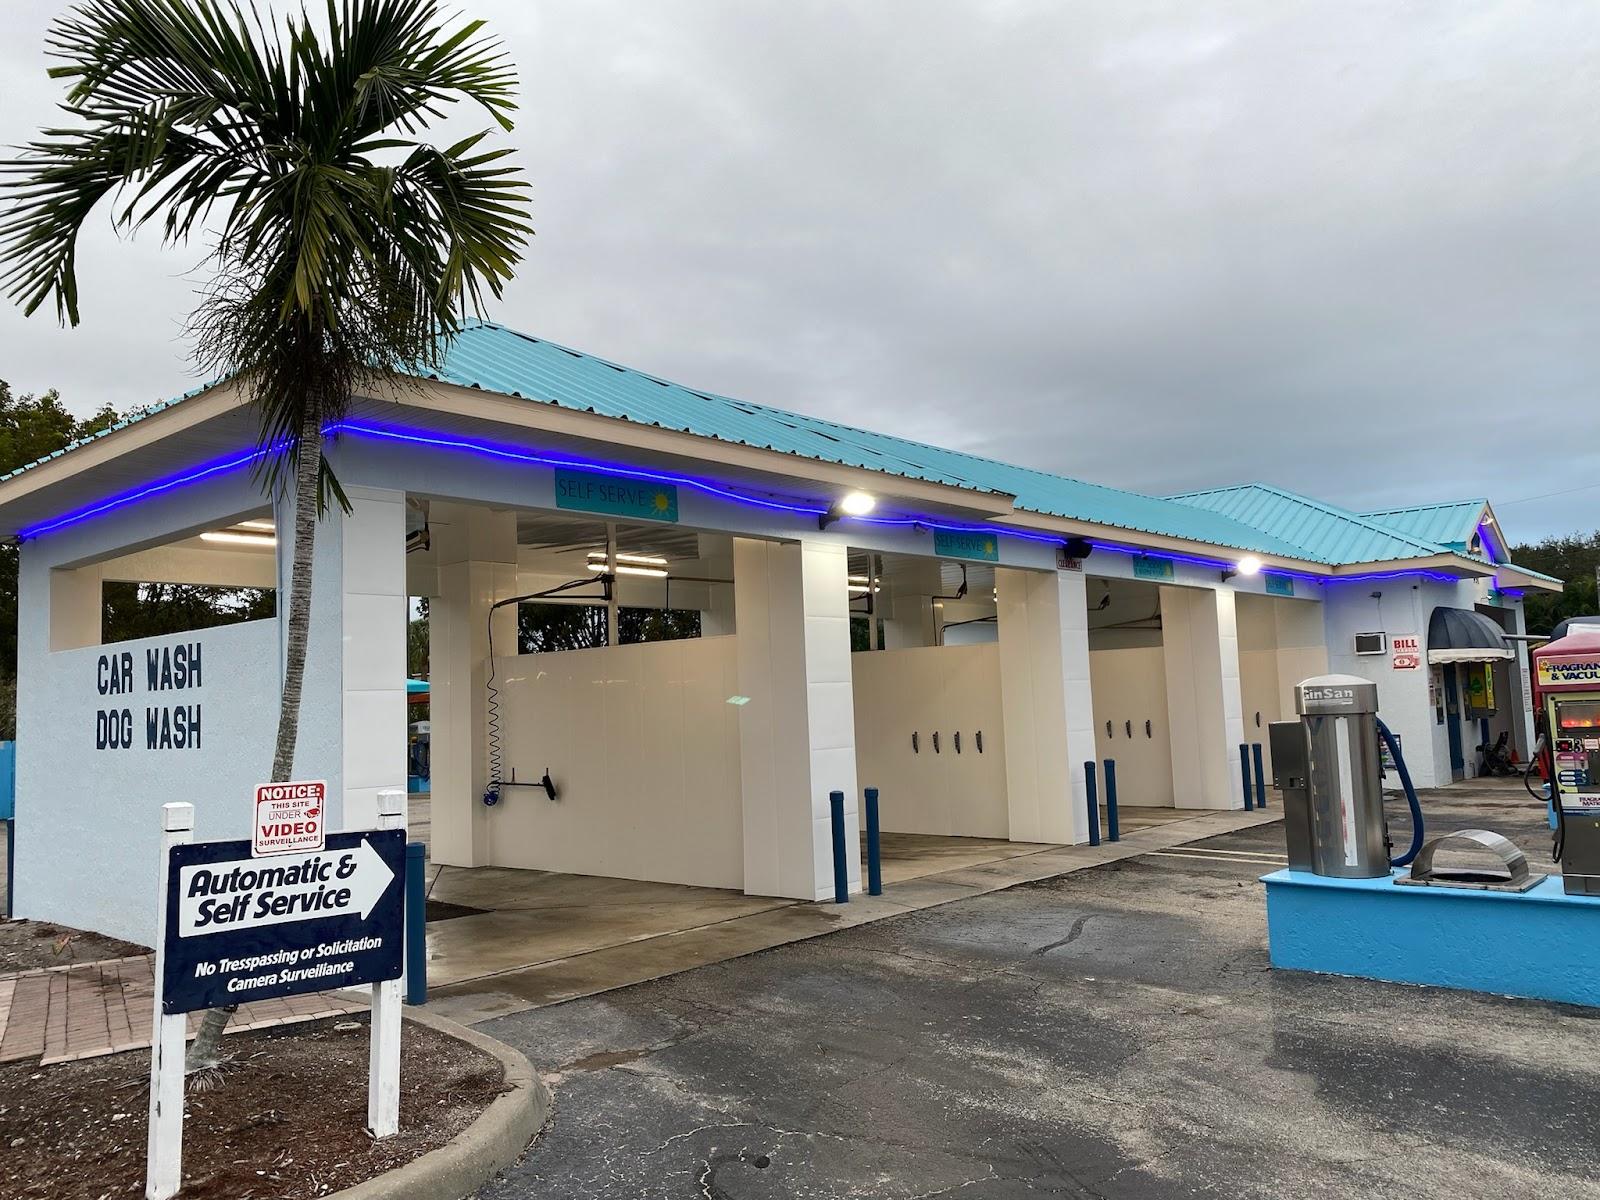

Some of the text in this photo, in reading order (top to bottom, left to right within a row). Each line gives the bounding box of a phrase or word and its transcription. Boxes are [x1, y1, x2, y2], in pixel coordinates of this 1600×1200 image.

[559, 478, 645, 506] SELF SERVE
[1393, 639, 1418, 649] BILL
[97, 642, 202, 695] CAR WASH
[1551, 672, 1560, 681] &
[96, 704, 202, 750] DOG WASH
[261, 785, 321, 800] NOTICE:
[268, 810, 301, 820] UNDER
[259, 835, 319, 846] SURVEILLANCE
[261, 821, 317, 838] VIDEO
[187, 854, 357, 898] Automatic &
[194, 885, 351, 928] Self Service
[195, 936, 382, 977] No Tresspassing or Solicitation
[227, 960, 354, 993] Camera Surveillance
